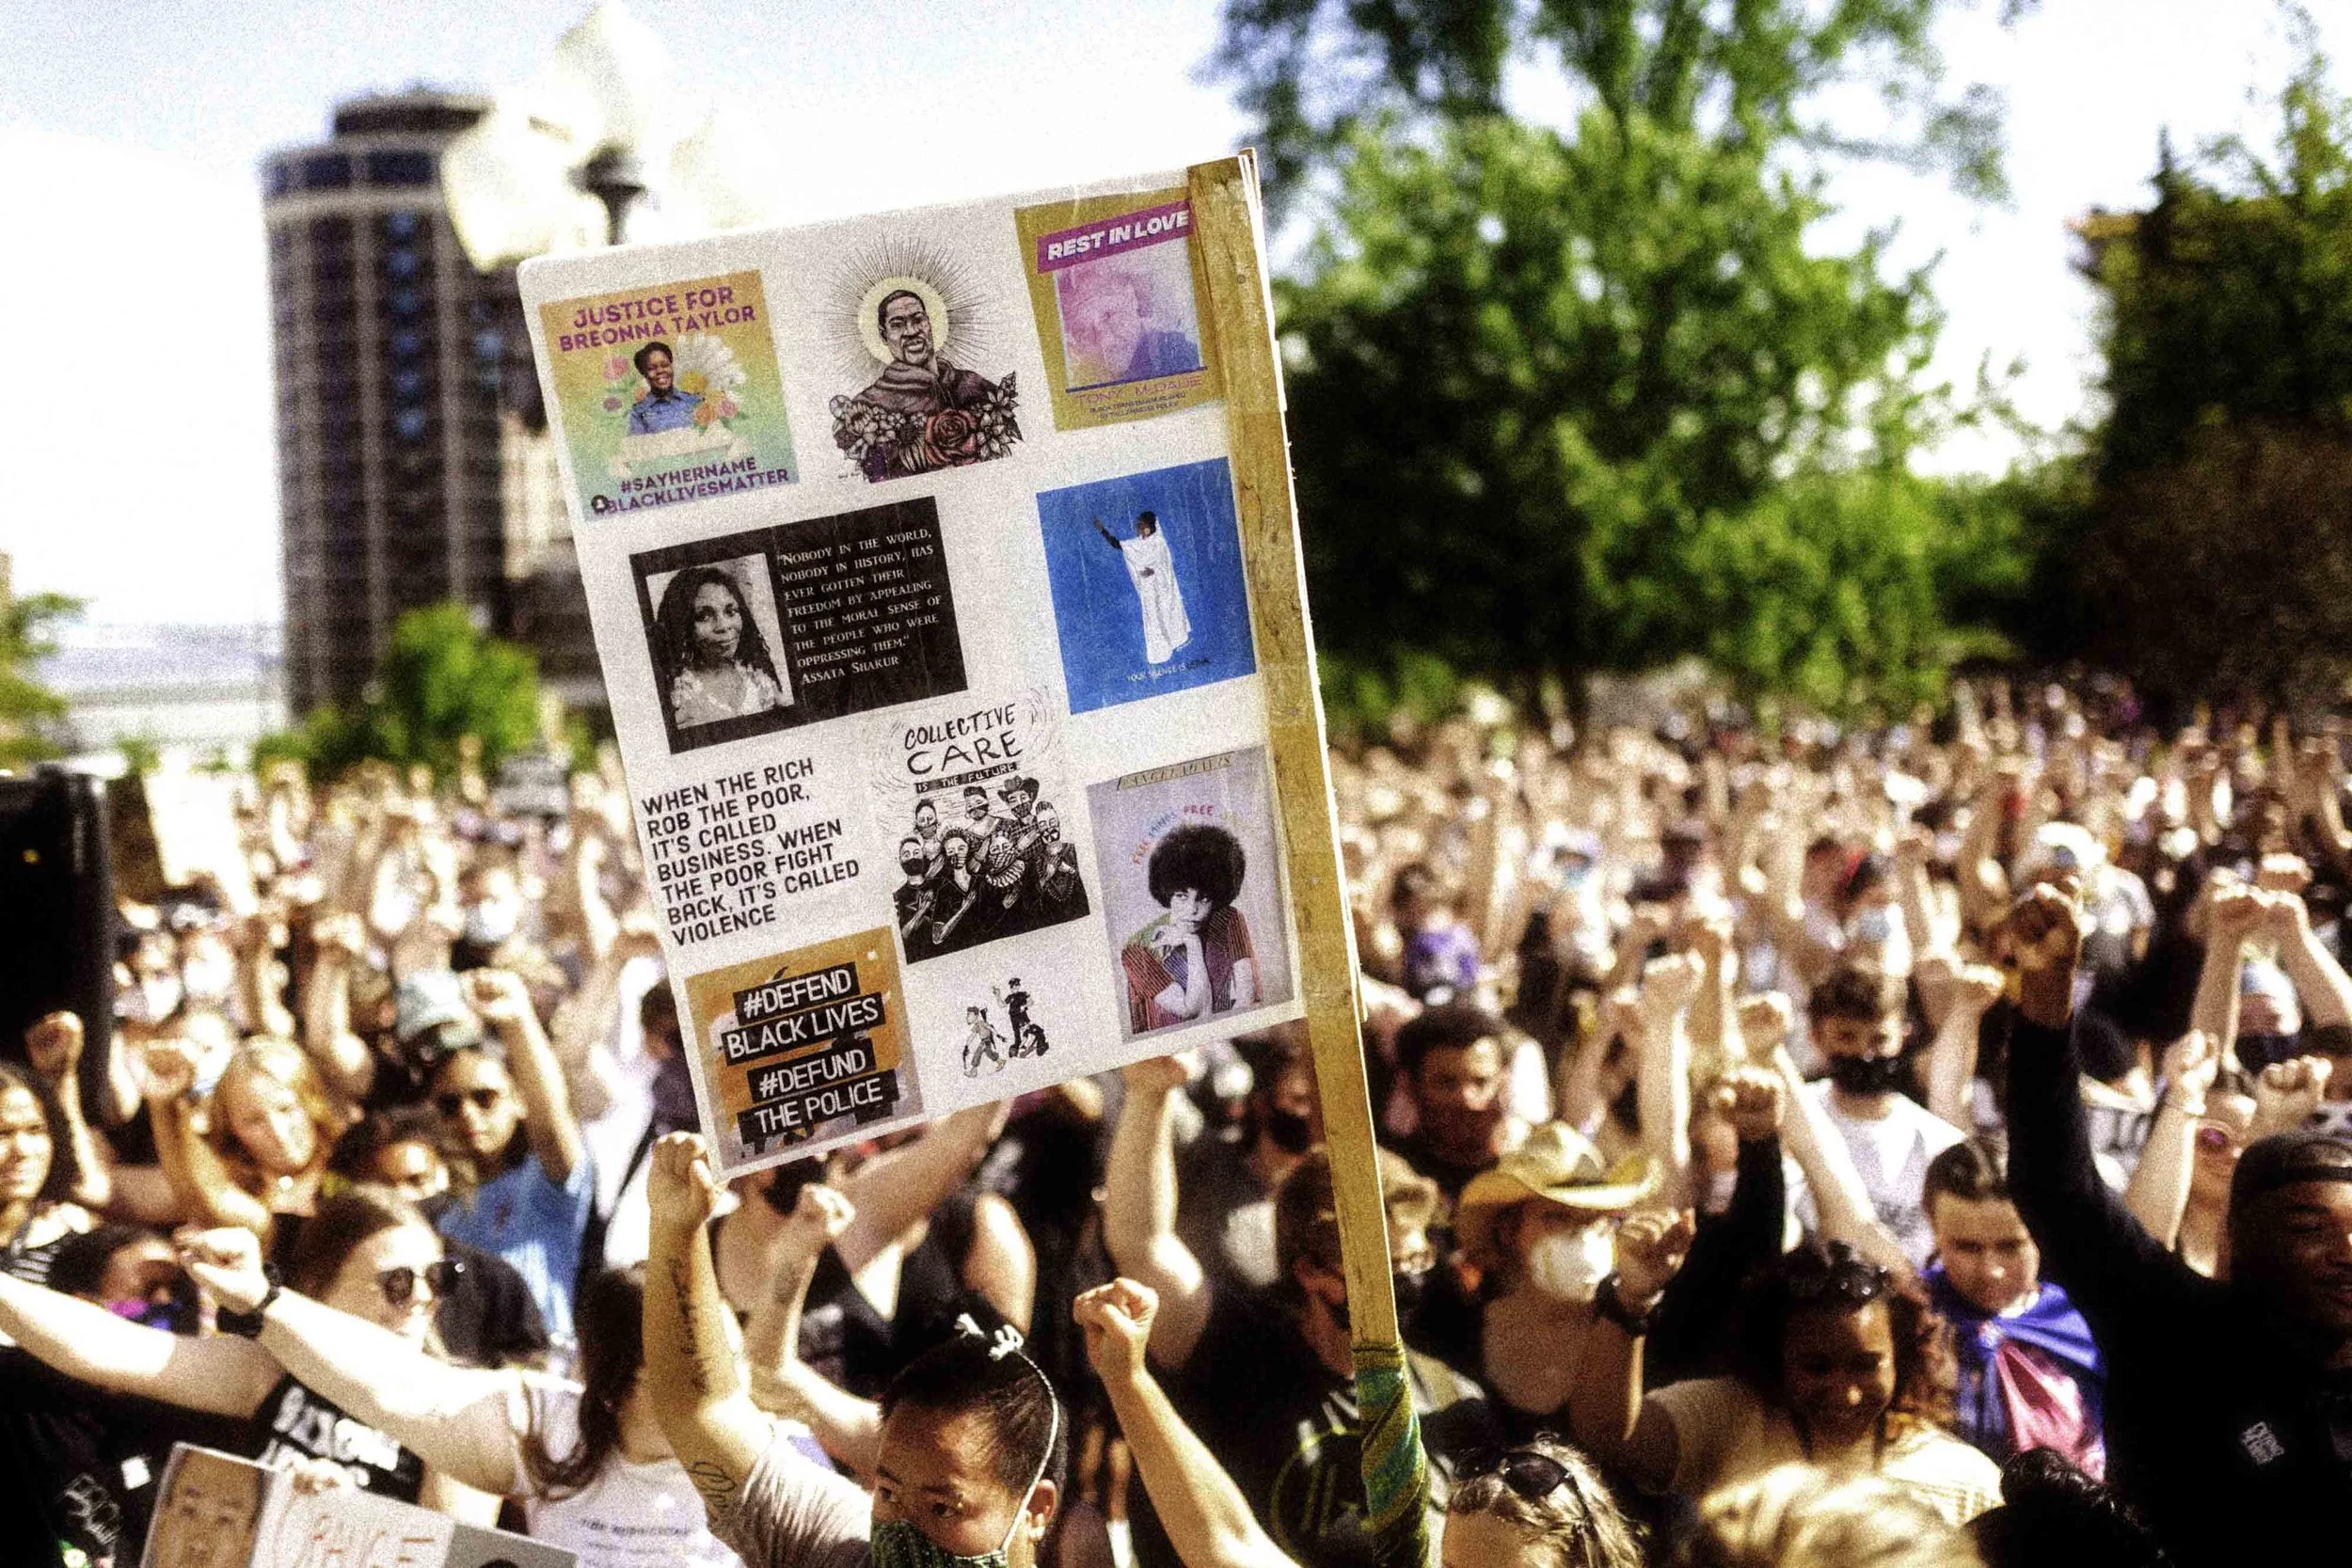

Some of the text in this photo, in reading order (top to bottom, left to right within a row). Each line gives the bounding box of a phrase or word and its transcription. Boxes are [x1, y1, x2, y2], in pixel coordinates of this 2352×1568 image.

[1047, 211, 1189, 261] REST IN LOVE
[559, 306, 756, 352] BREONNA TAYLOR
[574, 286, 734, 328] JUSTICE FOR
[621, 457, 756, 493] #SAYHERNAME
[781, 566, 829, 584] NOBODY
[836, 562, 847, 573] IN
[912, 545, 934, 558] HAS
[840, 545, 851, 554] IN
[859, 538, 880, 549] THE
[786, 569, 905, 601] EVER GOTTEN THEIR
[787, 580, 932, 618] FREEDOM BY APPEALING
[791, 594, 941, 634] TO THE MORAL SENSE OF
[794, 613, 939, 652] THE PEOPLE WHO WERE
[798, 647, 866, 668] OPPRESSING
[904, 704, 1016, 750] COLLECTIVE
[907, 730, 1024, 775] CARE
[642, 757, 814, 816] WHEN THE RICH
[917, 764, 1015, 792] IS THE FUTURE
[647, 813, 691, 838] ROB
[699, 800, 739, 824] THE
[652, 814, 776, 860] IT'S CALLED
[658, 818, 842, 881] BUSINESS. WHEN
[662, 844, 834, 903] THE POOR FIGHT
[668, 860, 860, 926] BACK, IT'S CALLED
[672, 904, 776, 945] VIOLENCE
[743, 969, 852, 1019] #DEFEND
[726, 998, 878, 1058] BLACK LIVES
[759, 1049, 866, 1098] #DEFUND
[755, 1077, 883, 1133] THE POLICE
